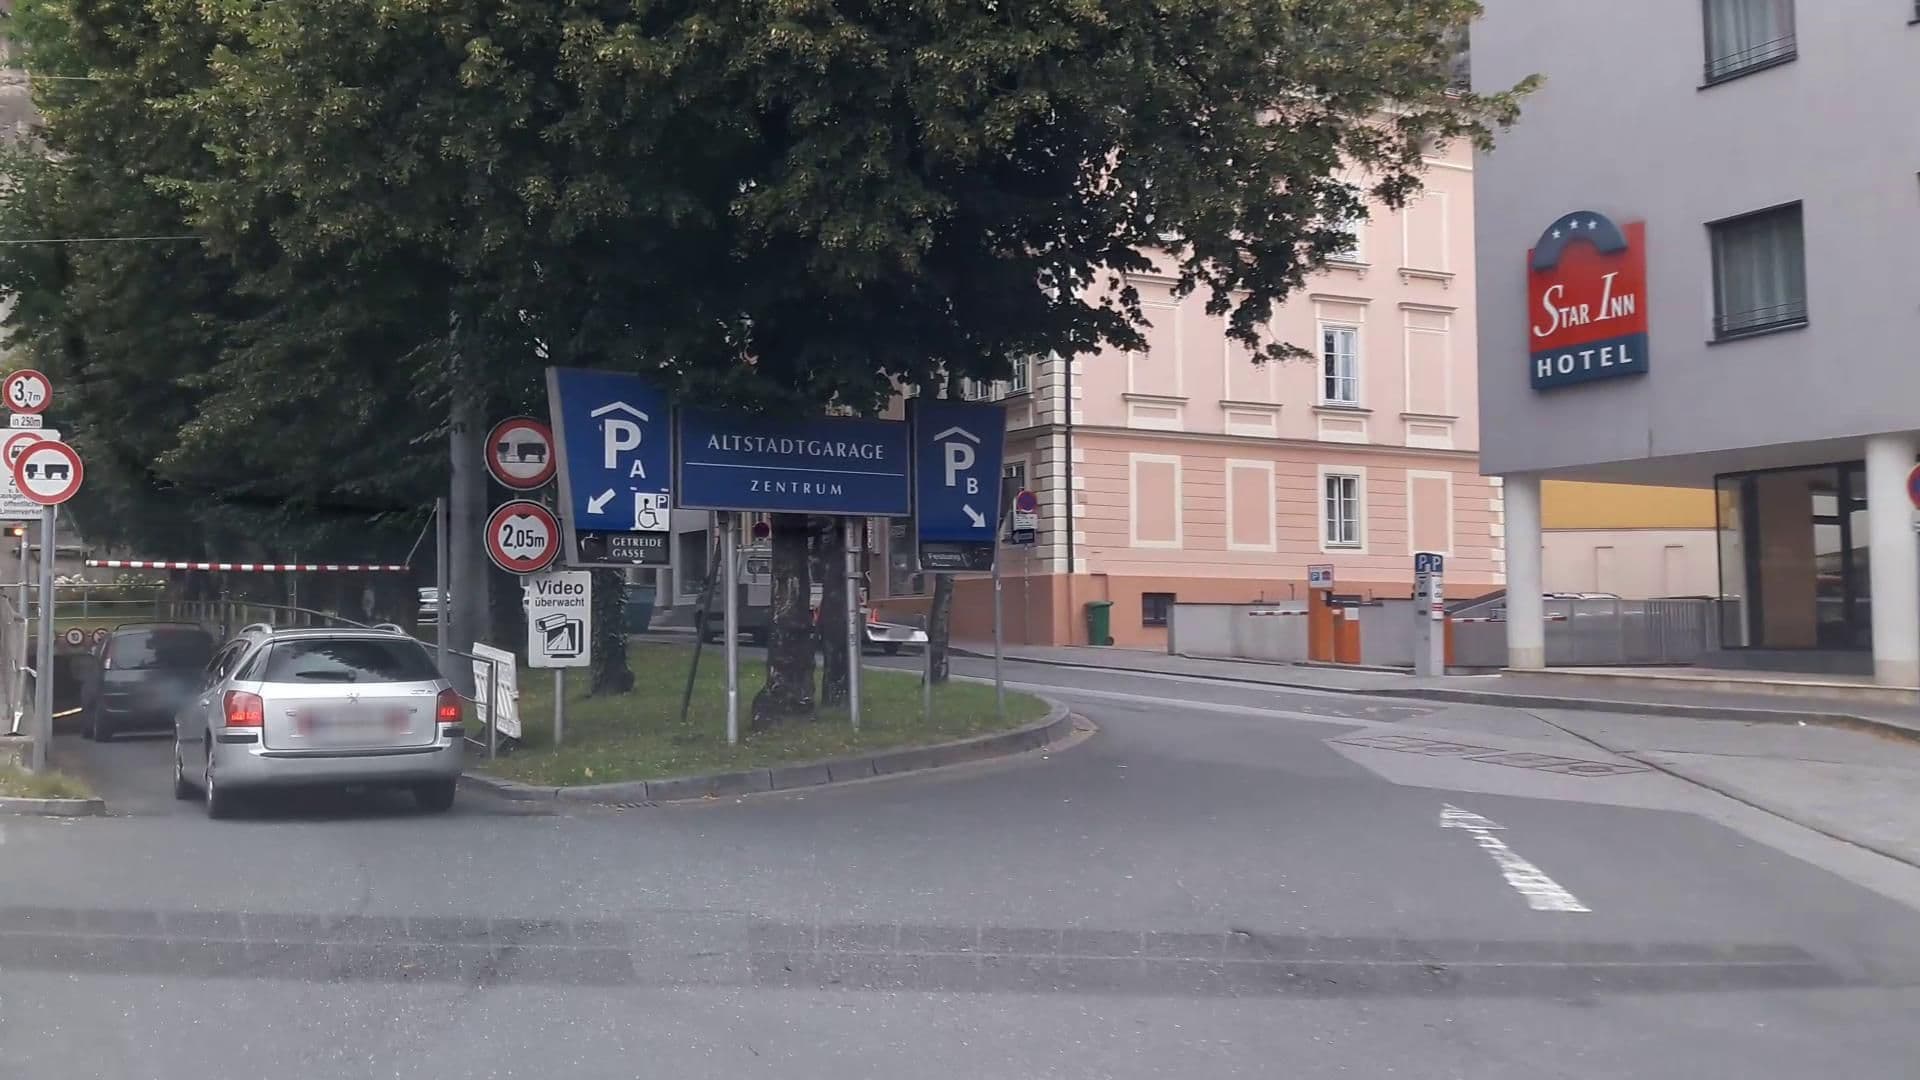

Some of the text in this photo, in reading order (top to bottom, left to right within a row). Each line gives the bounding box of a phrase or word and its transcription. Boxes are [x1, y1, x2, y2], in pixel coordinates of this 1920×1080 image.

[1537, 344, 1632, 378] HOTEL
[604, 418, 642, 469] P
[707, 434, 885, 460] ALTSTADTGARAGE
[629, 459, 646, 479] A
[944, 441, 975, 487] P
[750, 480, 842, 495] ZENTRUM
[967, 477, 978, 495] B
[503, 525, 545, 550] 2,05m
[612, 536, 662, 548] GETREIDE
[612, 548, 645, 558] GASSE
[536, 580, 584, 595] Video
[535, 597, 585, 608] überwacht
